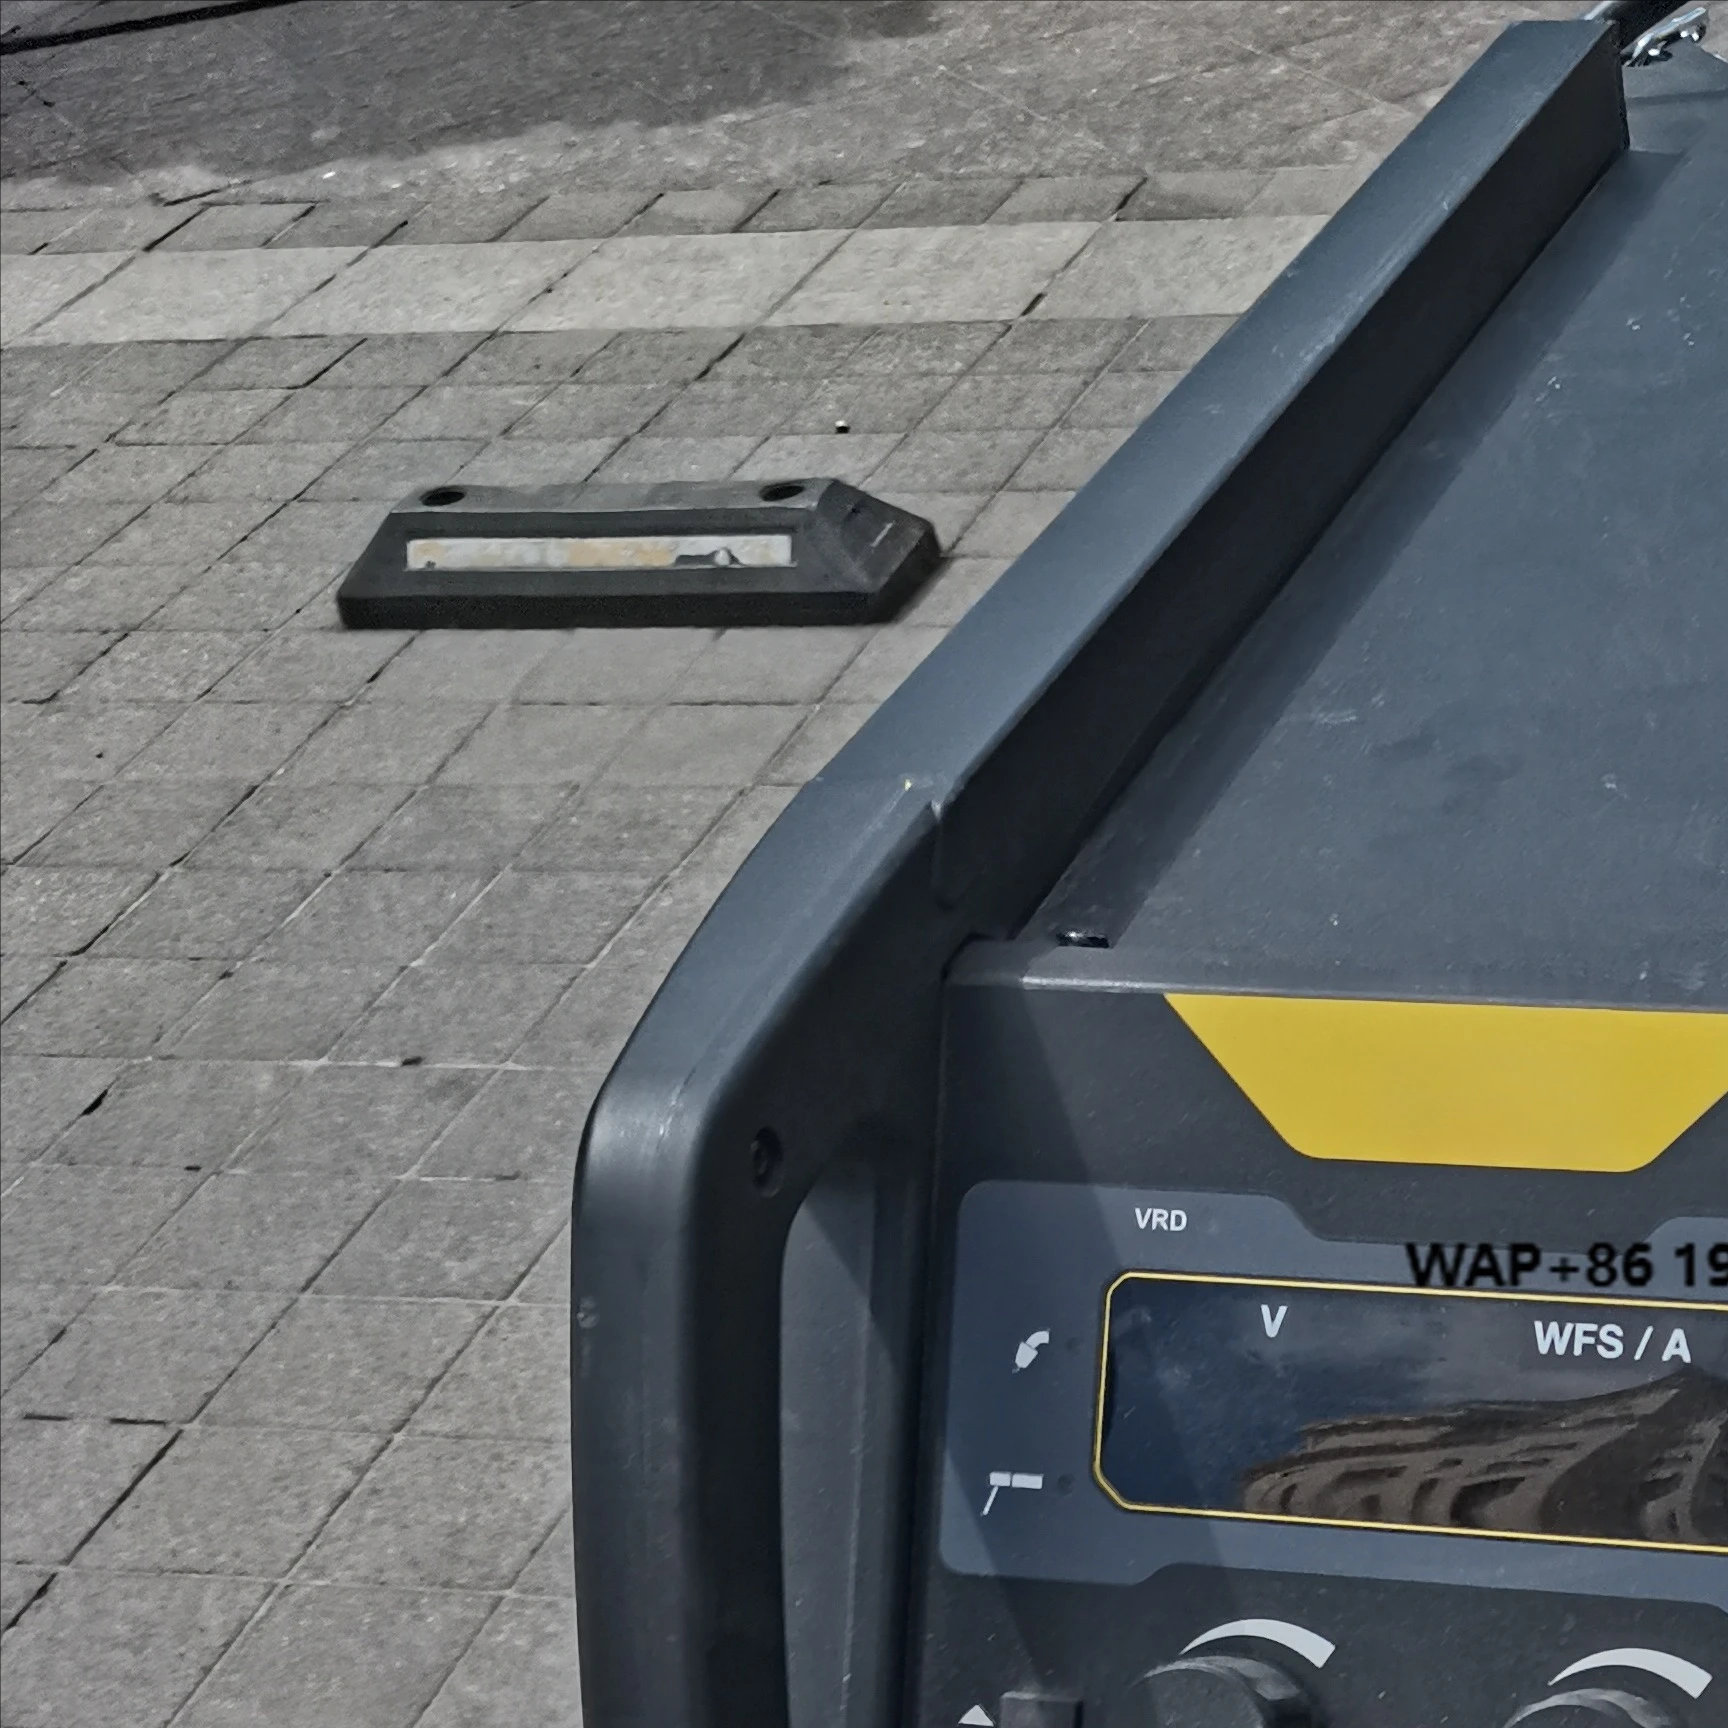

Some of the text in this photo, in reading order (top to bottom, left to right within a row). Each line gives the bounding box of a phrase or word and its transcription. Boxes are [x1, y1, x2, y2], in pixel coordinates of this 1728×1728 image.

[1134, 1206, 1188, 1233] VRD
[1260, 1303, 1289, 1339] V
[1533, 1320, 1624, 1360] WFS
[1660, 1326, 1693, 1364] A
